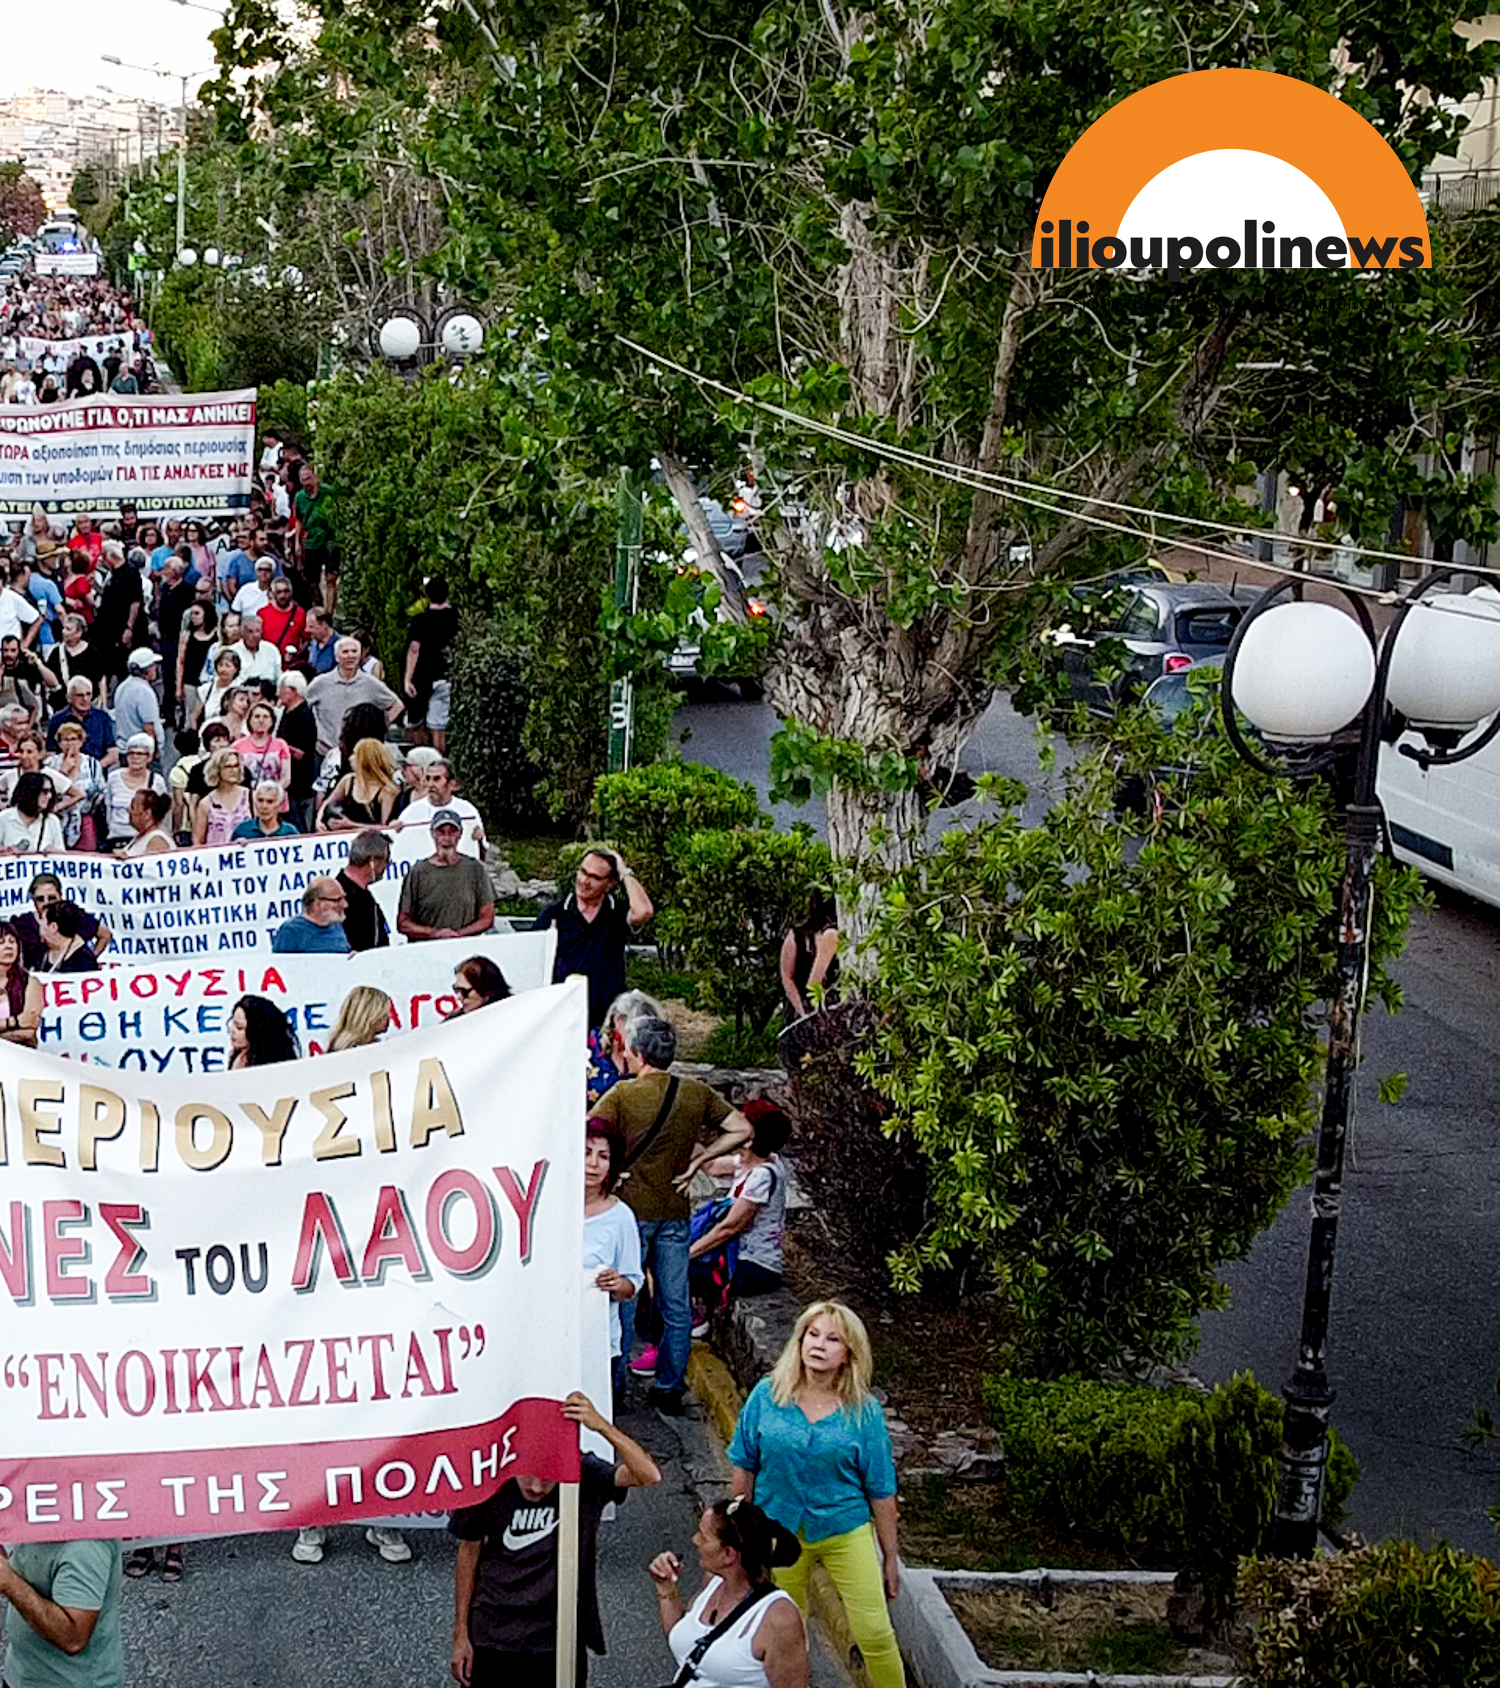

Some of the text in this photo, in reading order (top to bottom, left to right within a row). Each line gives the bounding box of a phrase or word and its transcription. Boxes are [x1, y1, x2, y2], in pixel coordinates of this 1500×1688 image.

[87, 408, 113, 426] ΓΙΑ
[152, 406, 188, 424] ΜΑΣ
[101, 443, 120, 459] της
[26, 473, 49, 485] των
[117, 466, 136, 481] ΓΙΑ
[141, 465, 160, 480] ΤΙΣ
[164, 464, 224, 480] ΑΝΑΓΚΕΣ
[156, 857, 210, 878] 1984,
[219, 851, 245, 871] ΜΕ
[254, 845, 303, 866] ΤΟΥΣ
[313, 840, 350, 861] ΑΓΩ
[122, 884, 180, 905] ΚΙΝΤΗ
[190, 880, 223, 900] ΚΑΙ
[233, 874, 268, 894] ΤΟΥ
[122, 912, 134, 930] Η
[143, 901, 257, 929] ΔΙΟΙΚΗΤΙΚΗ
[218, 930, 257, 950] ΑΠΟ
[176, 1242, 269, 1295] του
[290, 1159, 551, 1293] ΛΑΟΥ
[161, 1471, 290, 1518] ΤΗΣ
[324, 1425, 518, 1507] ΠΟΛΗΣ
